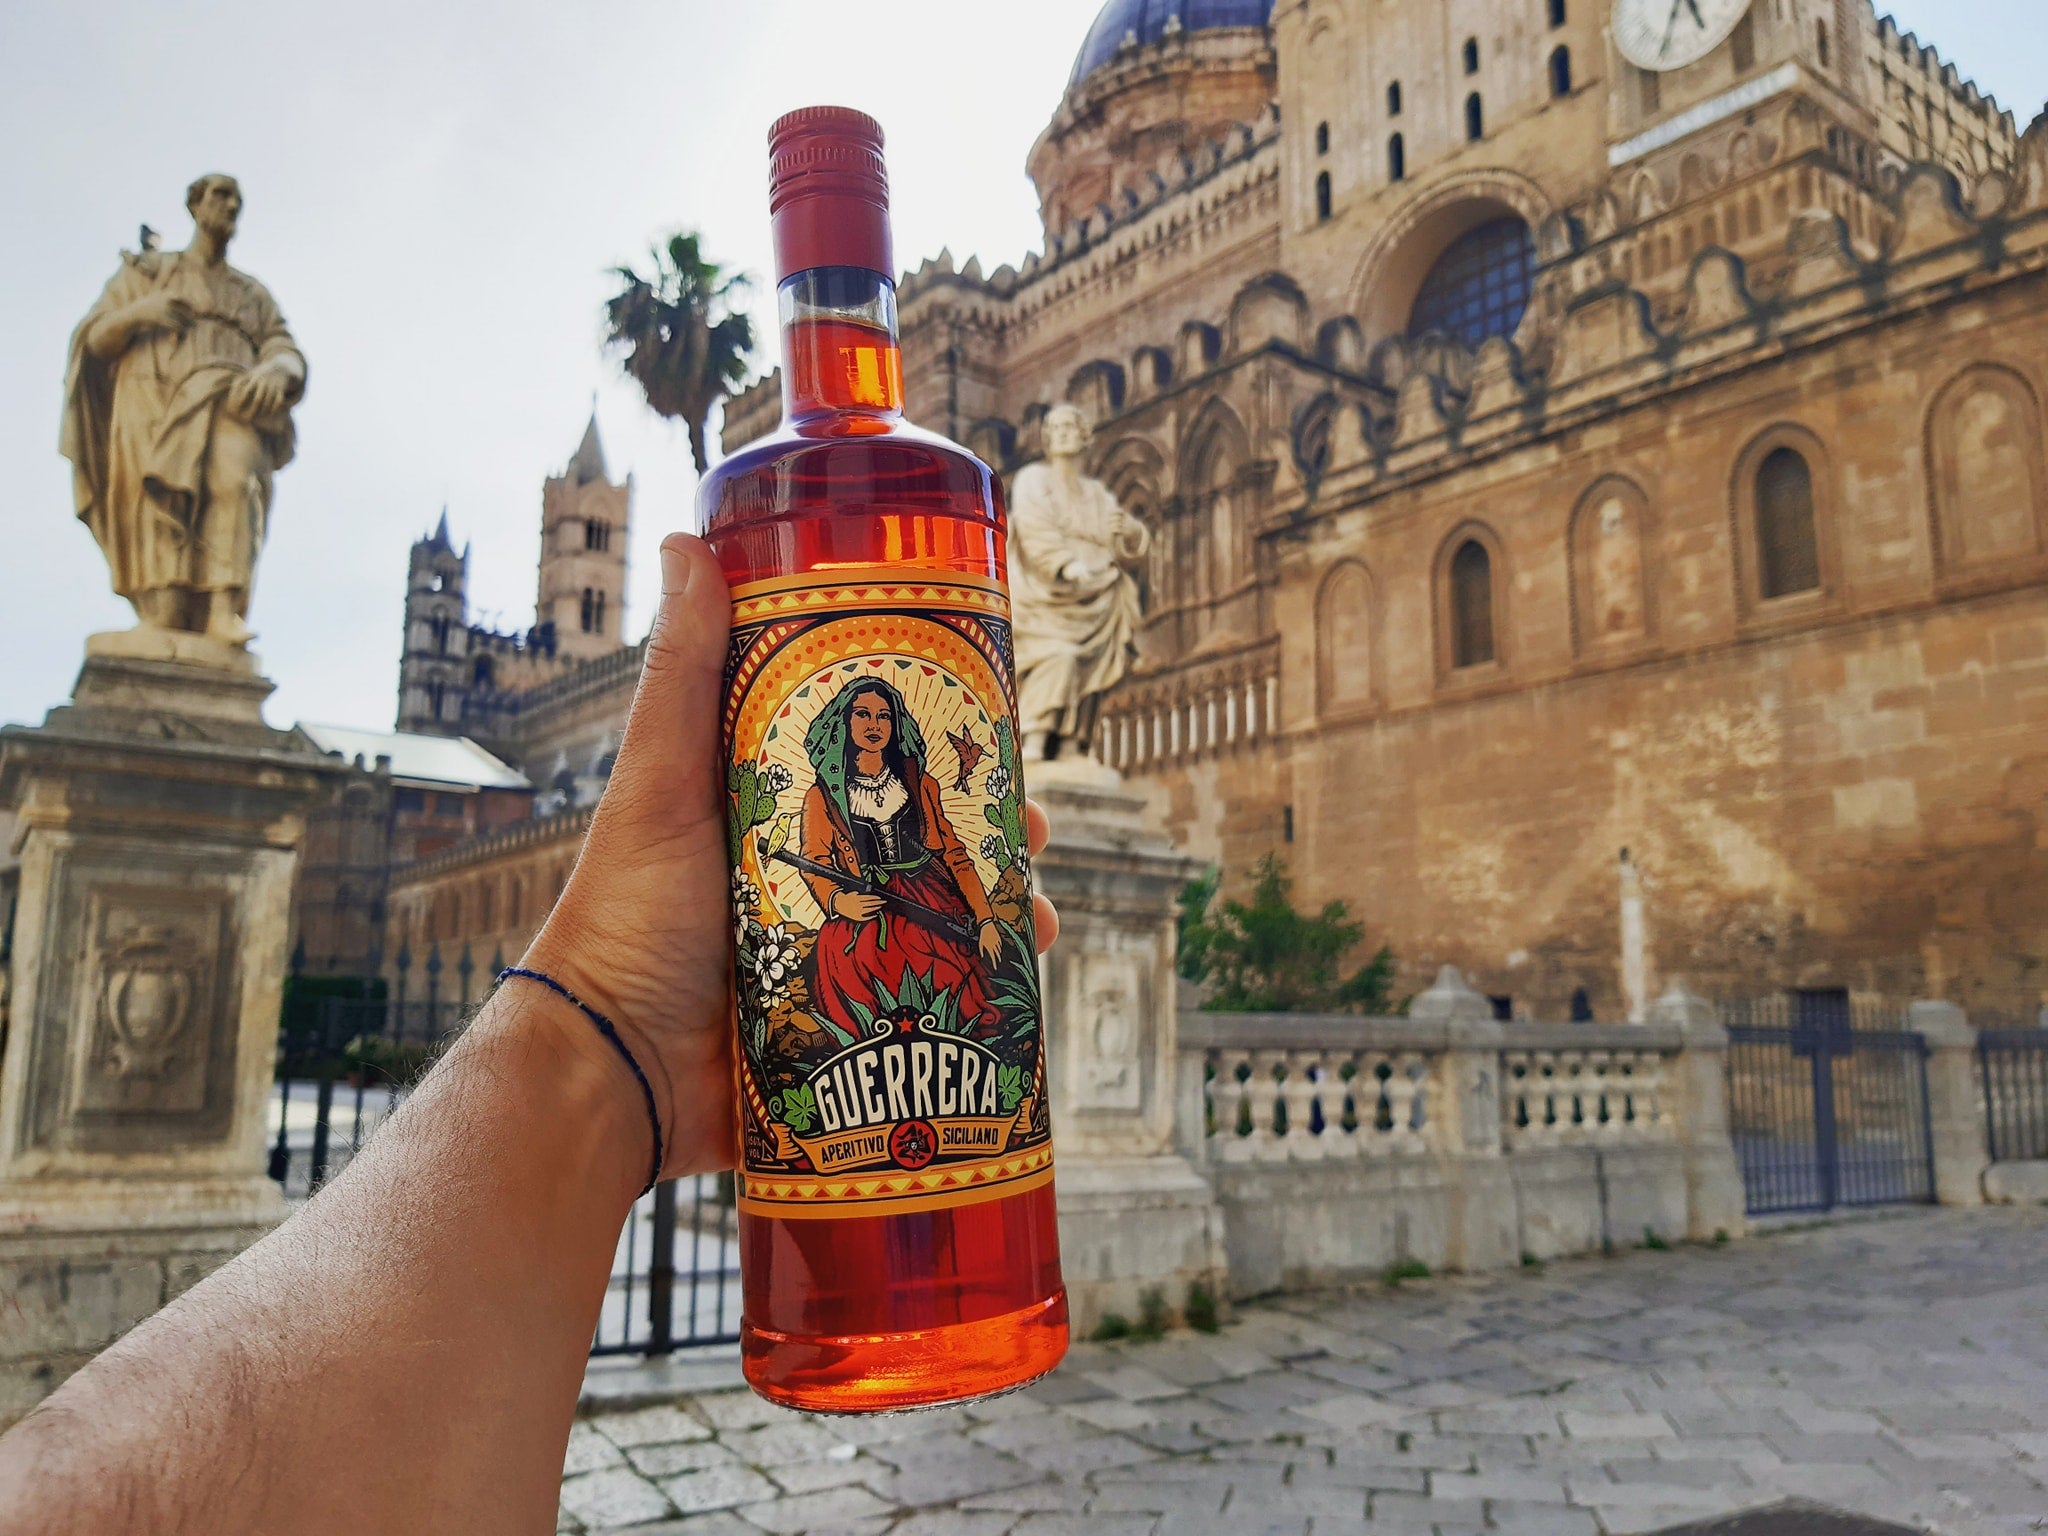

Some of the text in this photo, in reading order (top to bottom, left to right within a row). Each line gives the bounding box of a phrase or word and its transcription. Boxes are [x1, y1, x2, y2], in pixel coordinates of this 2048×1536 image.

[815, 1042, 997, 1132] GUERRERA
[821, 1127, 999, 1164] APERITIVO SICILIANO
